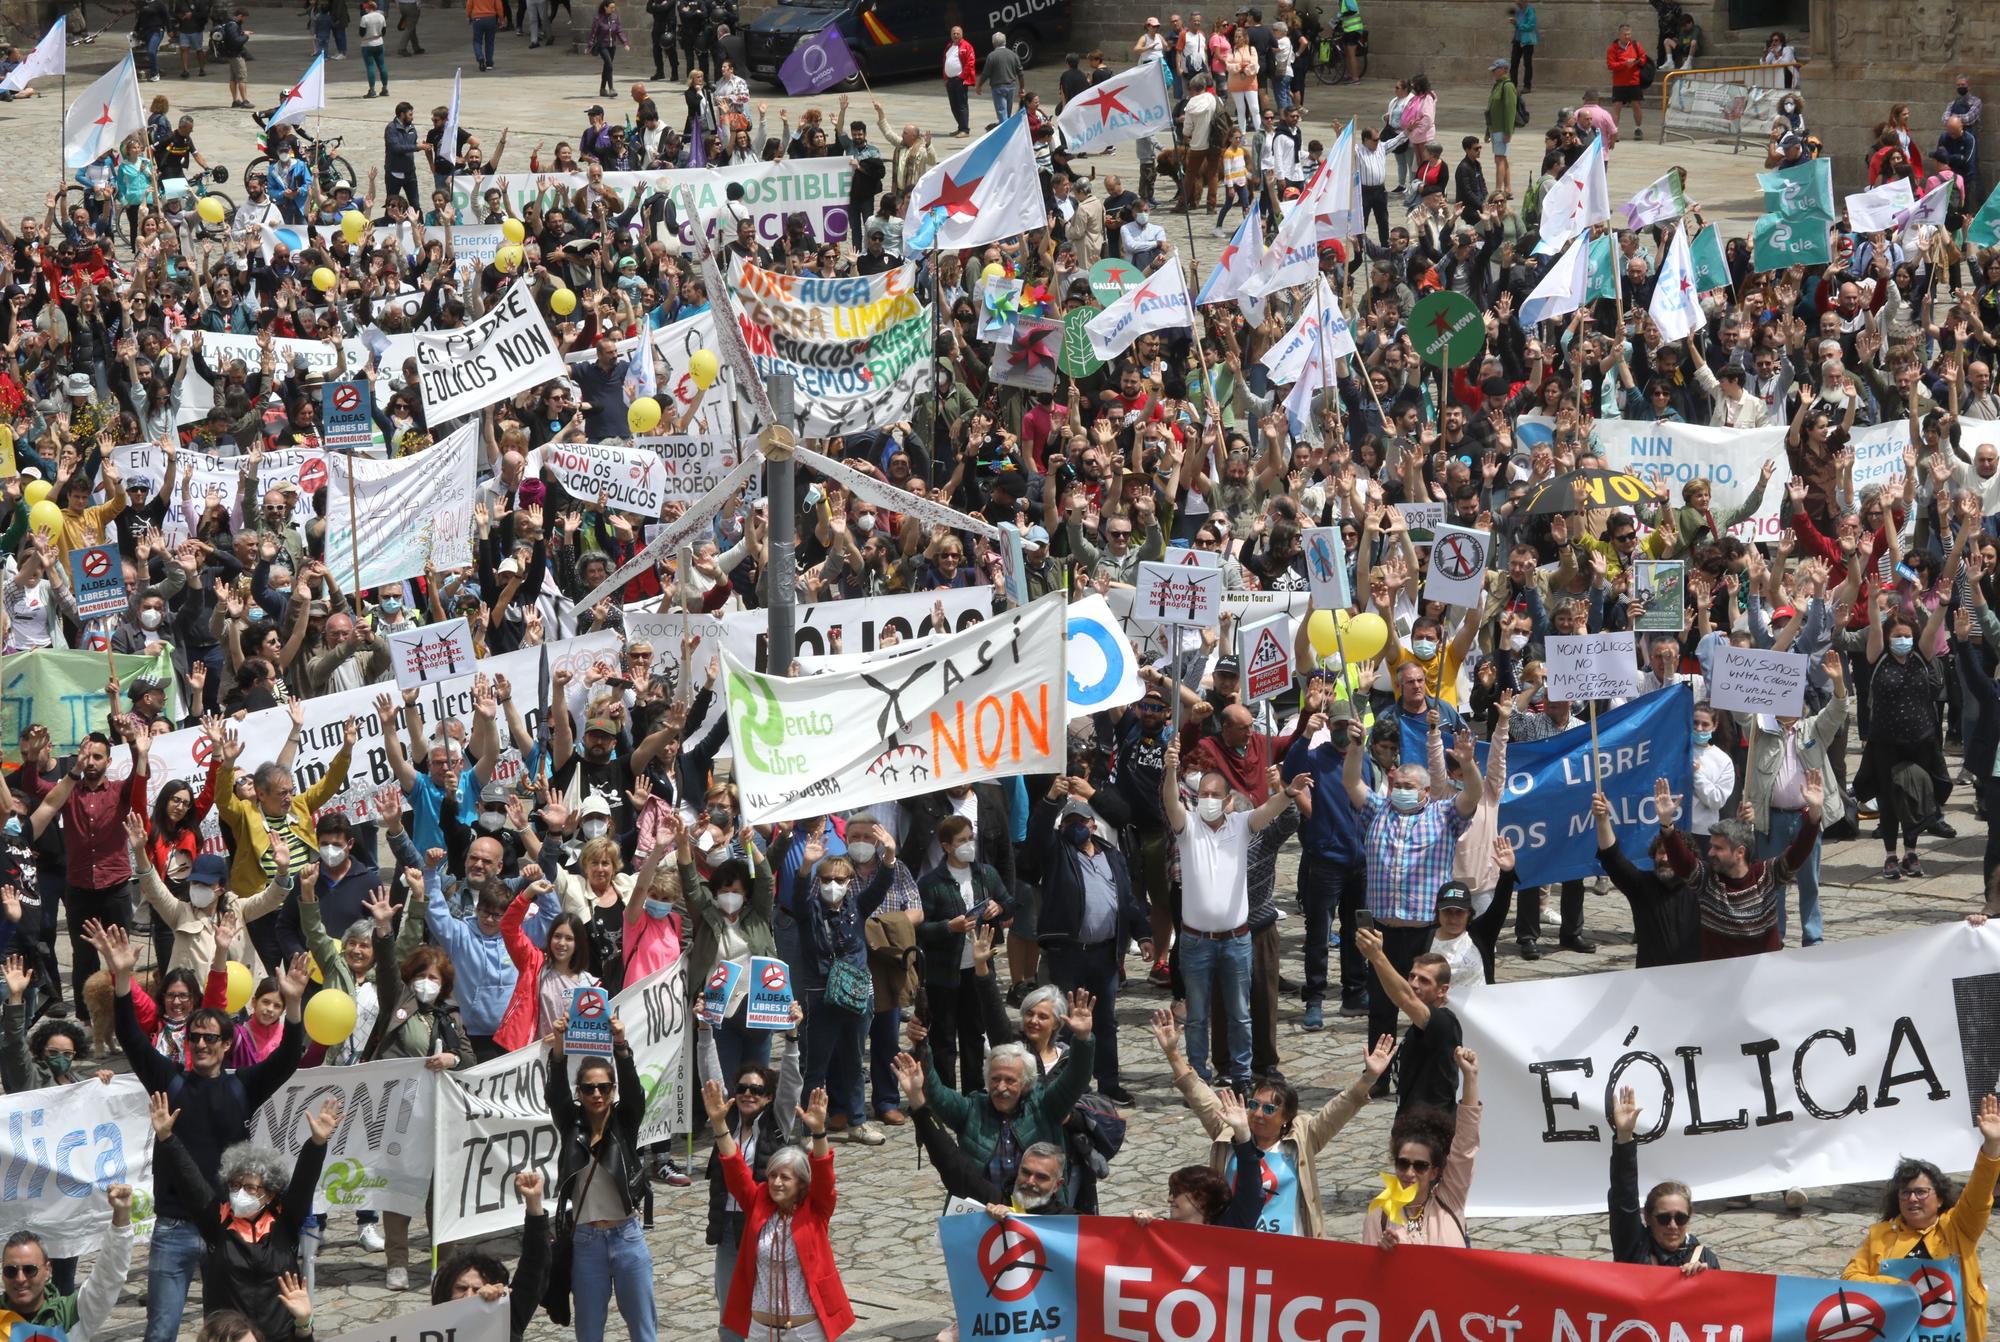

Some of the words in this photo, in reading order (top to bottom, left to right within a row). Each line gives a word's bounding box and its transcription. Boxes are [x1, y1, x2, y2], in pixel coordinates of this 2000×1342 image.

[988, 0, 1063, 28] POLIC
[726, 172, 850, 205] OSTIBLE
[453, 233, 499, 246] Enerxía
[454, 249, 495, 260] susten
[800, 277, 870, 305] AUGA
[1092, 282, 1120, 291] GALIZA
[742, 296, 827, 340] ERRA
[1425, 331, 1454, 355] GALIZA
[1453, 311, 1477, 333] NOVA
[495, 323, 551, 372] NON
[330, 413, 366, 424] ALDEAS
[327, 423, 353, 434] LIBRES
[354, 423, 369, 432] DE
[1630, 436, 1673, 457] NIN
[1855, 436, 1904, 459] erxía
[130, 451, 150, 469] EN
[554, 451, 590, 473] NON
[593, 457, 612, 479] ÓS
[612, 451, 625, 465] DI
[80, 577, 118, 592] ALDEAS
[1272, 576, 1310, 591] adidas
[79, 589, 110, 603] LIBRES
[110, 587, 123, 596] DE
[1227, 593, 1250, 603] Monte
[1251, 593, 1274, 603] Toural
[1557, 643, 1583, 656] NON
[1586, 640, 1634, 655] EÓLICOS
[1575, 658, 1593, 671] NO
[1725, 653, 1757, 668] NON
[1553, 672, 1608, 686] MACIZO
[1729, 670, 1760, 682] UNHA
[1578, 679, 1633, 691] CENTRAL
[1720, 682, 1731, 691] O
[1734, 683, 1776, 696] RURAL
[931, 683, 1051, 778] NON
[1562, 740, 1652, 786] LIBRE
[754, 992, 791, 1003] ALDEAS
[751, 1002, 781, 1012] LIBRES
[570, 1020, 609, 1031] ALDEAS
[567, 1030, 599, 1040] LIBRES
[599, 1032, 610, 1041] DE
[1528, 1016, 1952, 1145] EÓLICA
[676, 1084, 685, 1124] DUBRA
[1103, 1264, 1382, 1342] Eólica
[971, 1306, 1062, 1338] ALDEAS
